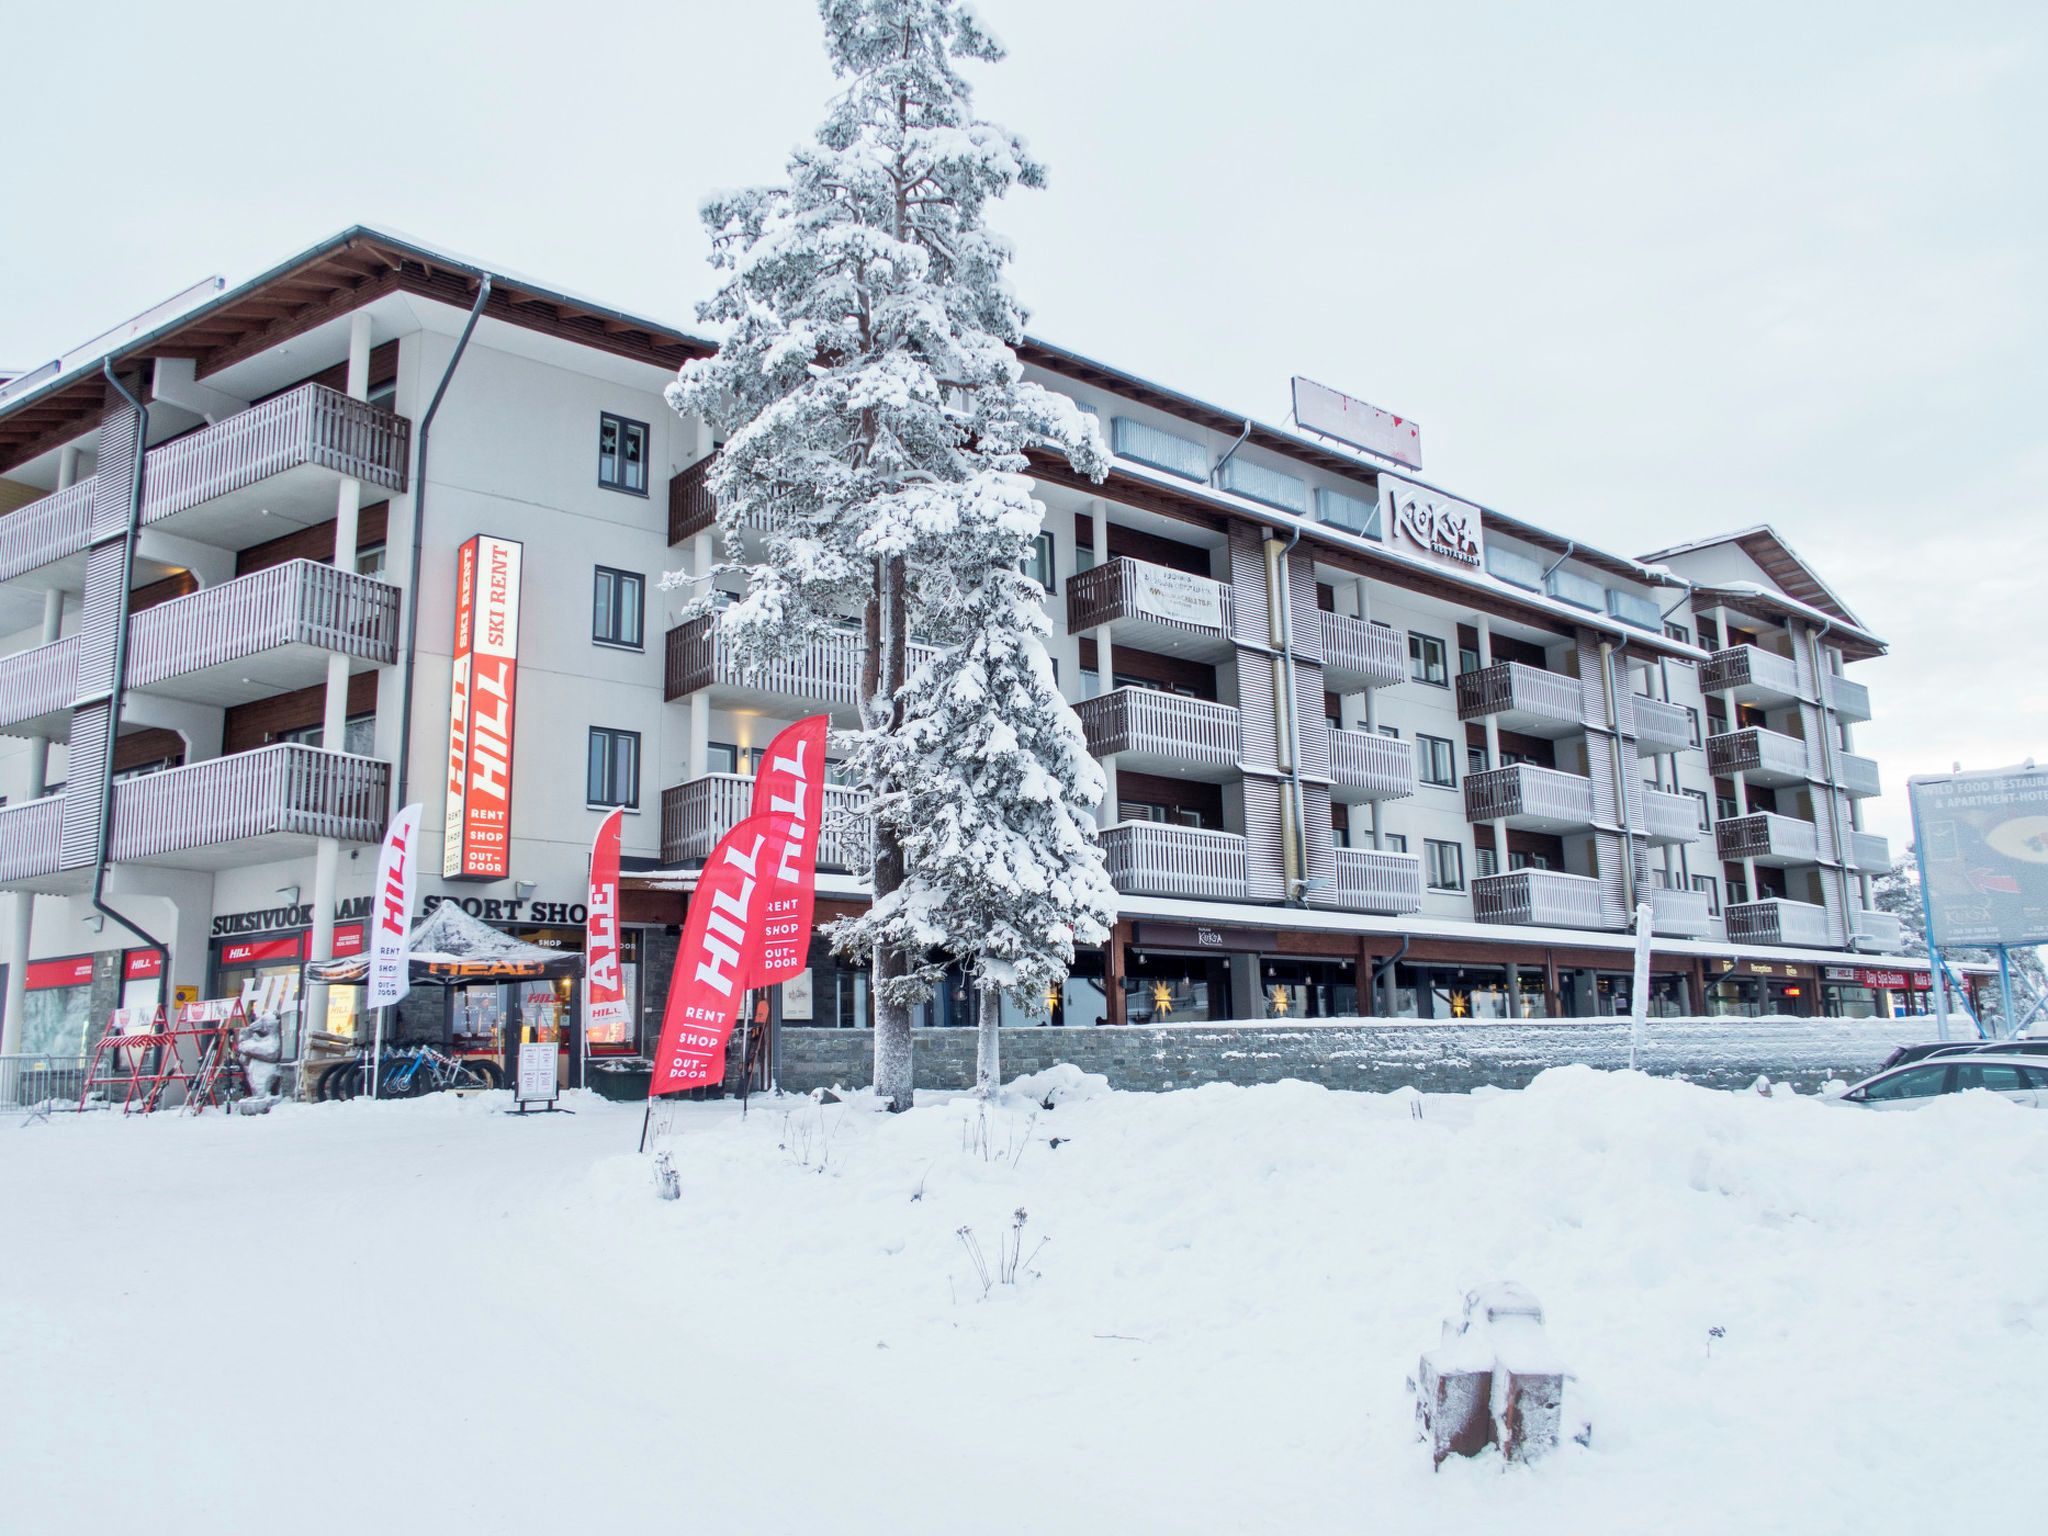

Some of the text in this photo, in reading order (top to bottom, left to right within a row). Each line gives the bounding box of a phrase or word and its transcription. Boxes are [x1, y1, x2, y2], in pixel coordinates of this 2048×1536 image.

[460, 548, 472, 648] SKI RENT
[488, 545, 508, 646] SKI RENT
[450, 662, 468, 796] HILL
[472, 662, 509, 800] HILL
[1957, 781, 1989, 793] FOOD
[471, 808, 504, 820] RENT
[470, 830, 504, 842] SHOP
[469, 852, 501, 862] OUT-
[468, 862, 502, 873] DOOR
[382, 823, 410, 937] HILL
[767, 899, 798, 912] RENT
[531, 902, 588, 924] SHO
[694, 833, 767, 998] HILL
[765, 923, 799, 936] SHOP
[538, 939, 562, 947] SHOP
[589, 883, 618, 992] ALE
[229, 948, 251, 959] HILL
[380, 947, 400, 955] RENT
[765, 948, 796, 958] OUT-
[131, 958, 151, 969] HILL
[429, 960, 544, 976] HEAD
[765, 957, 798, 969] DOOR
[1866, 970, 1877, 986] Day
[1877, 971, 1888, 987] Spa
[1888, 971, 1904, 985] Sauna
[686, 1007, 726, 1023] RENT
[679, 1033, 718, 1048] SHOP
[673, 1057, 708, 1069] OUT-
[669, 1068, 706, 1078] DOOR
